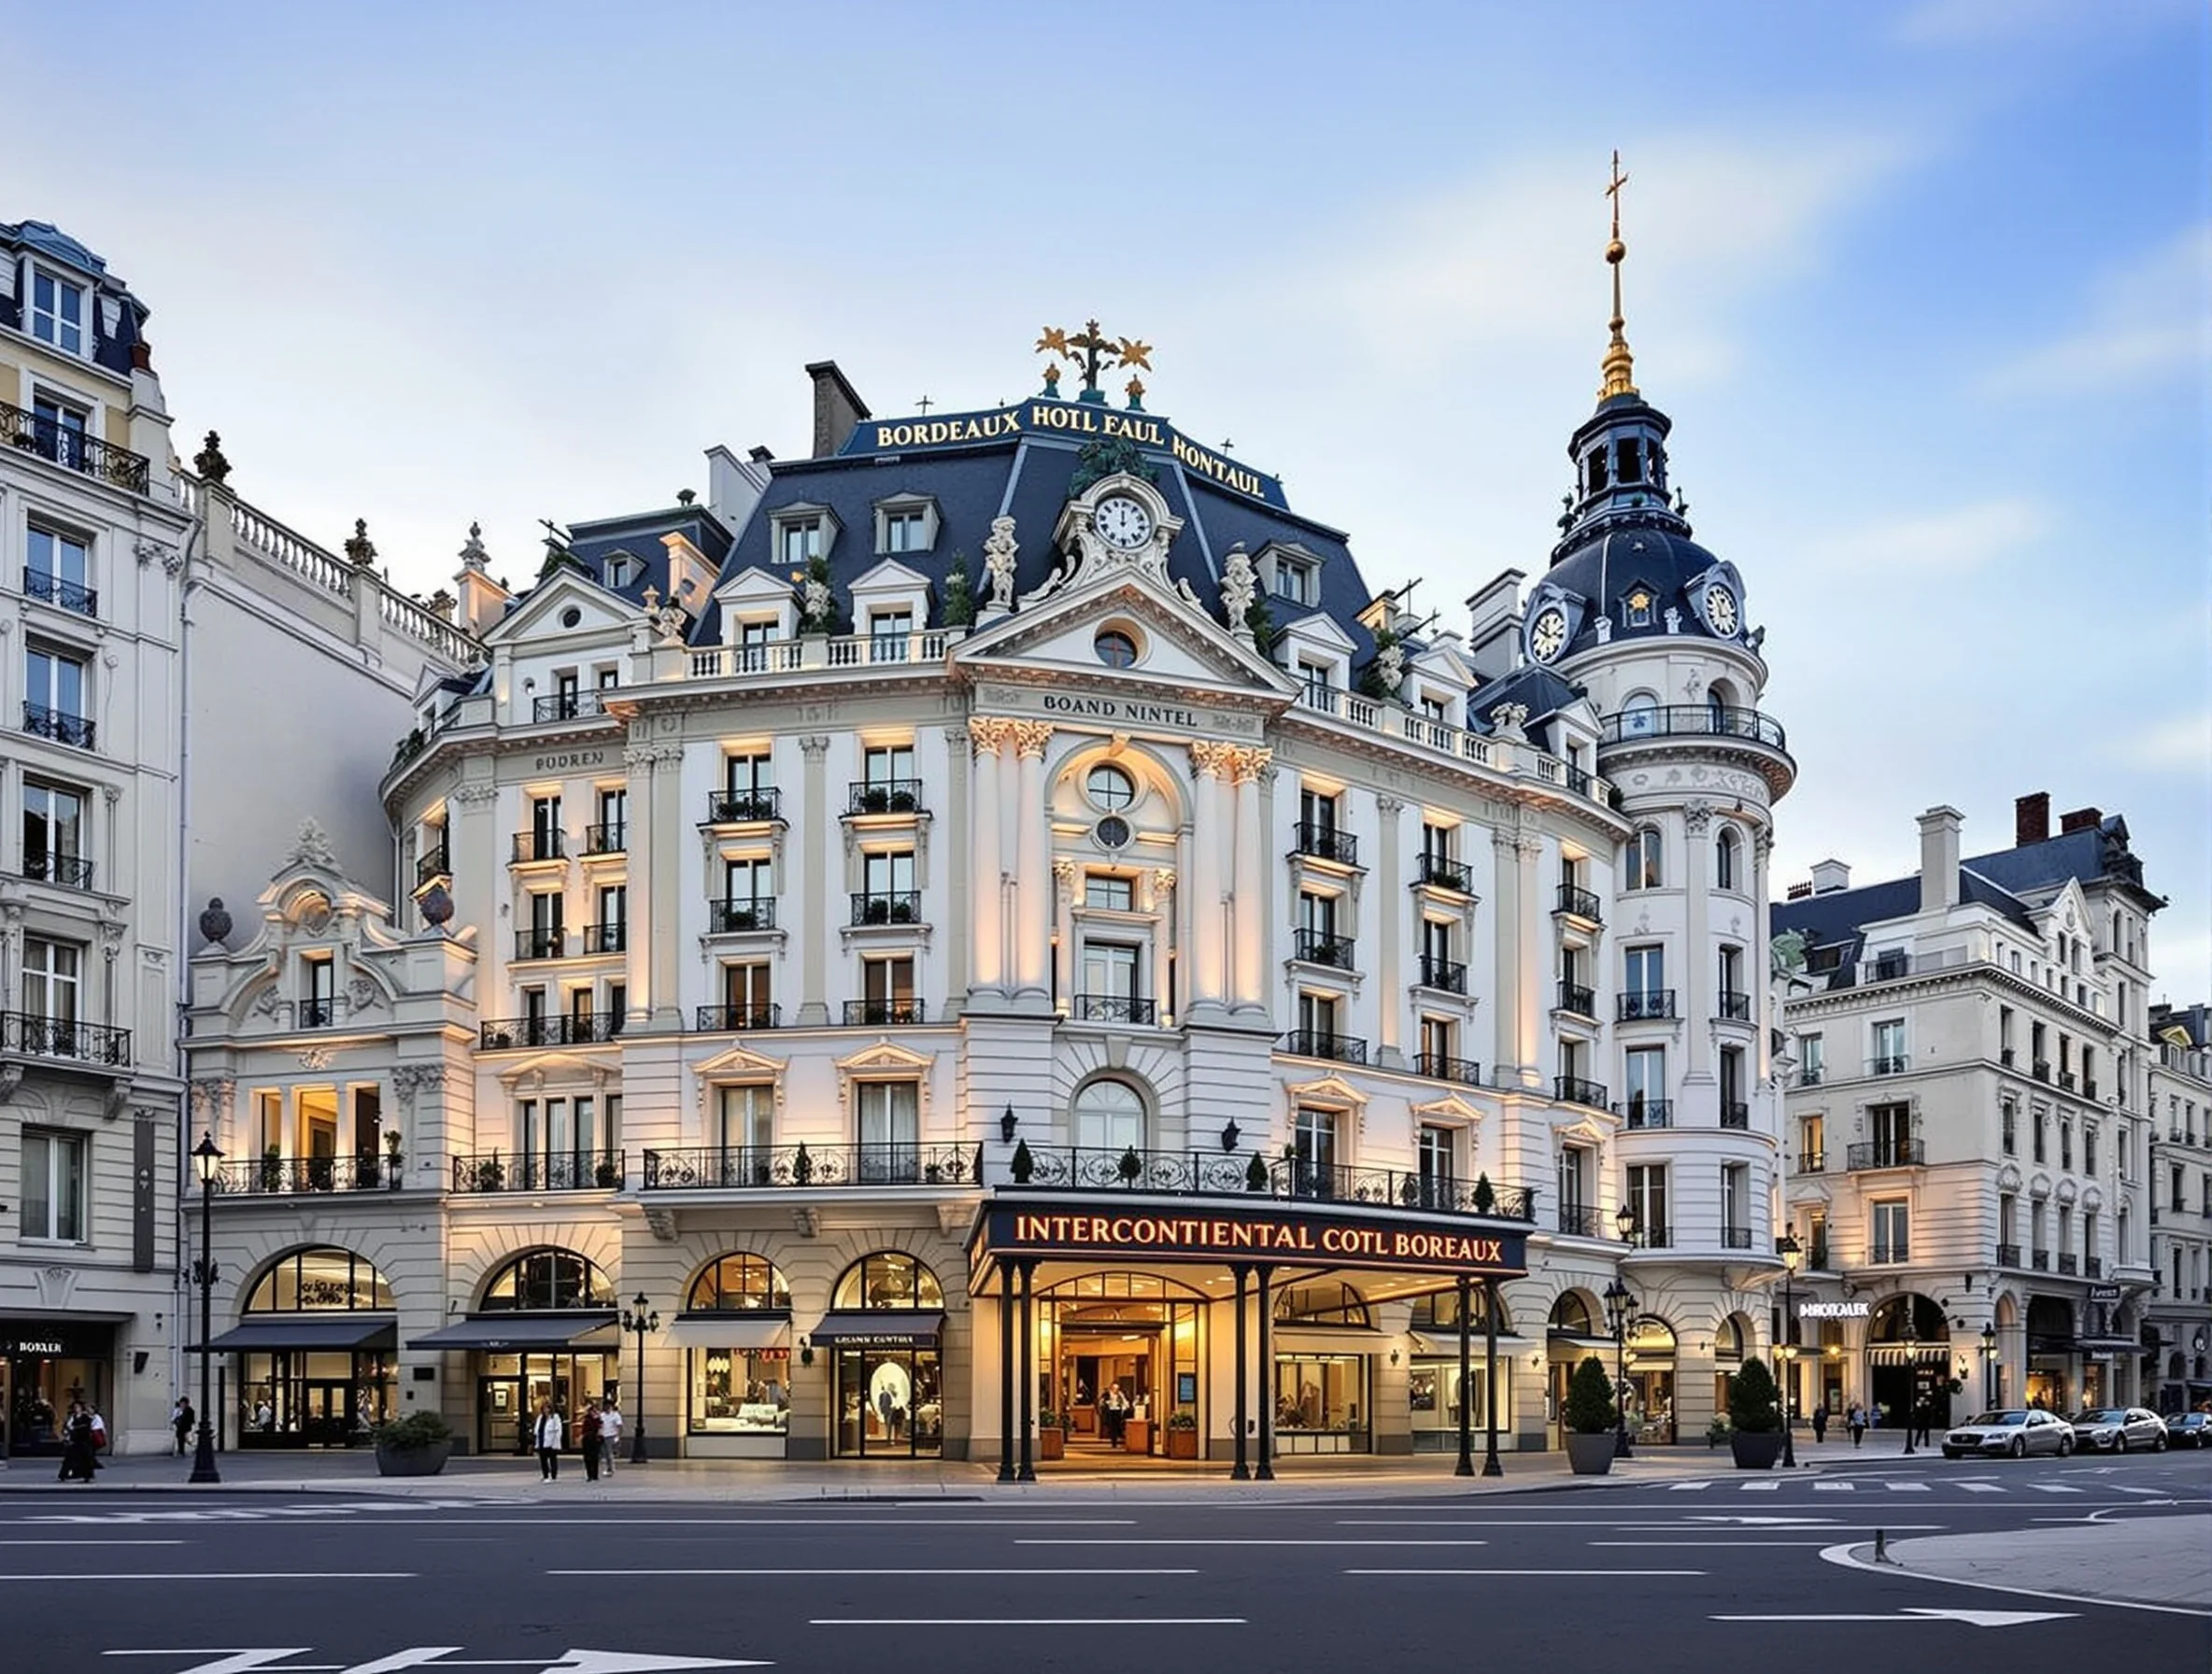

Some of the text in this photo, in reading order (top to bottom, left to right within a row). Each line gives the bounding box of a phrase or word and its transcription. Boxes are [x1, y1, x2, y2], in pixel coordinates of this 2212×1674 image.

[877, 410, 1021, 447] BORDEAUX
[1172, 434, 1265, 498] HONTAUL
[1043, 695, 1198, 728] BOAND NINTEL
[1015, 1216, 1502, 1261] INTERCONTIENTAL COTL BOREAUX
